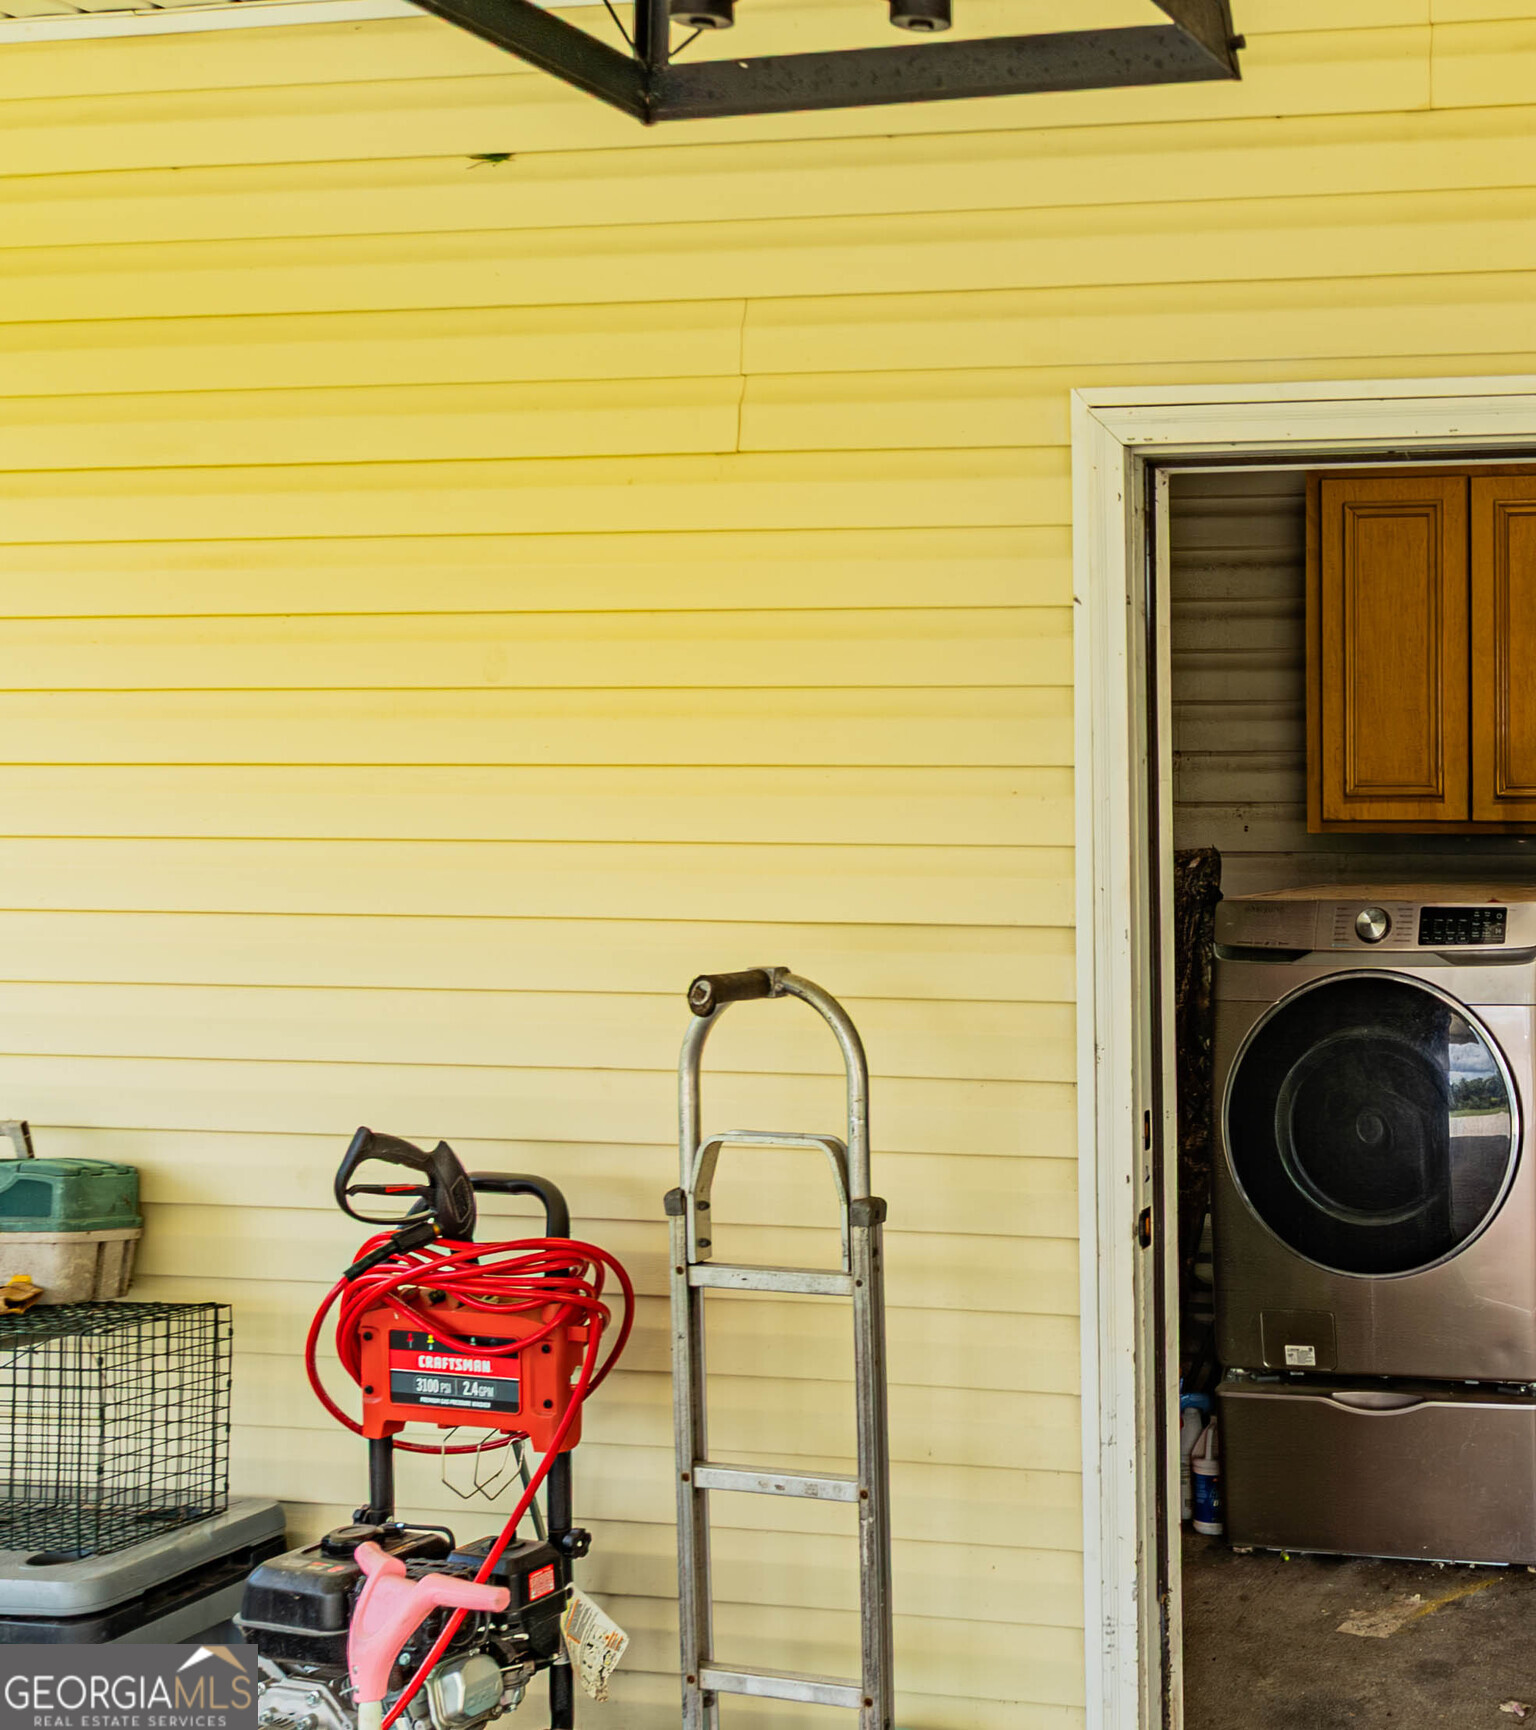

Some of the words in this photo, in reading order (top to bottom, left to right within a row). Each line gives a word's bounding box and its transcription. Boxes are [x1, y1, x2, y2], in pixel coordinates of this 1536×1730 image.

[418, 1355, 491, 1372] CRAFTSMAN
[416, 1378, 439, 1393] 3100
[440, 1382, 452, 1394] PSI
